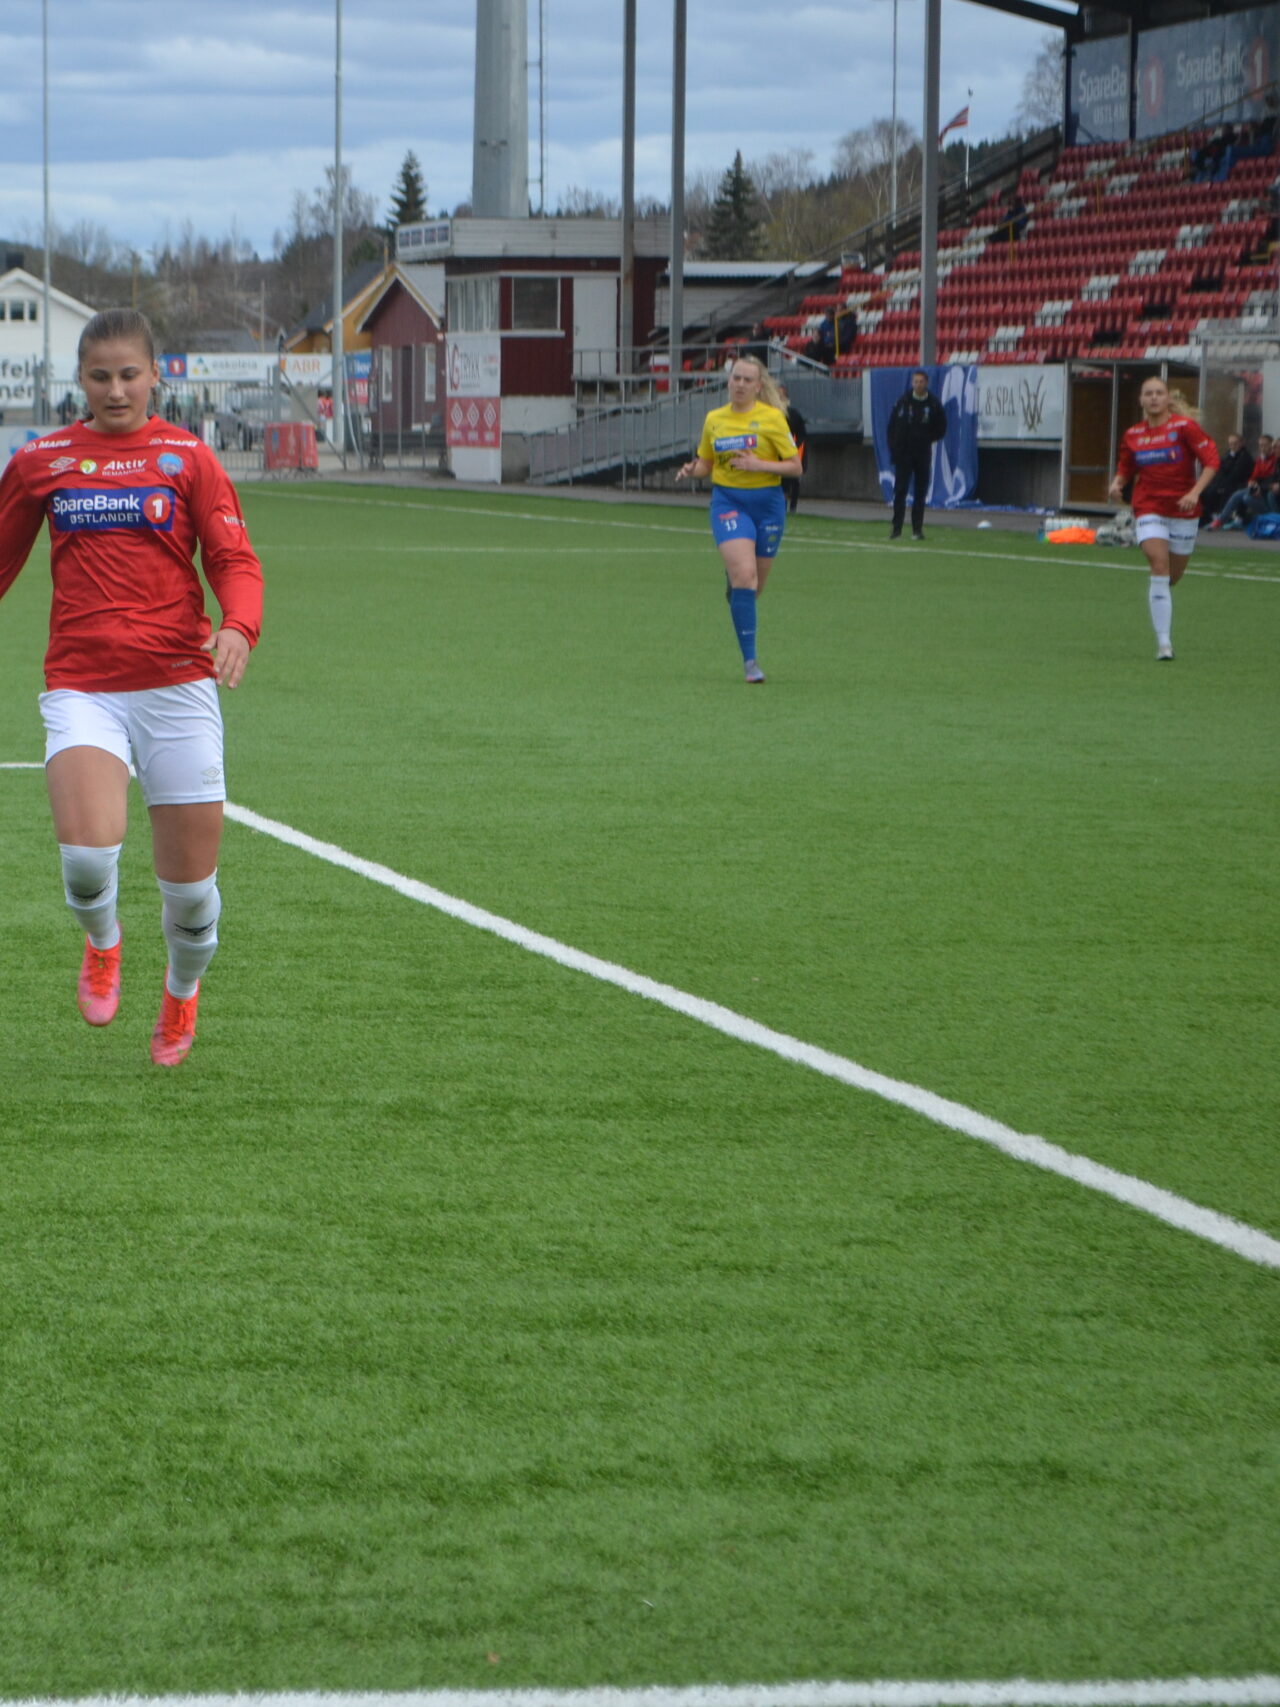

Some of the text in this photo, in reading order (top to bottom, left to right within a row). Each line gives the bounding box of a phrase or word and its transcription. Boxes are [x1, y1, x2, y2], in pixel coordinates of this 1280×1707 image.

[1253, 47, 1263, 88] 1
[1149, 66, 1157, 105] 1
[986, 387, 993, 415] &
[996, 385, 1015, 416] SPA
[38, 439, 71, 449] MAPEI
[164, 439, 197, 447] MAPEI
[103, 459, 147, 470] Aktiv
[53, 494, 163, 518] SpareBank 1
[70, 512, 141, 524] ØSTLANDET
[224, 515, 246, 528] umbo
[726, 519, 737, 531] 13
